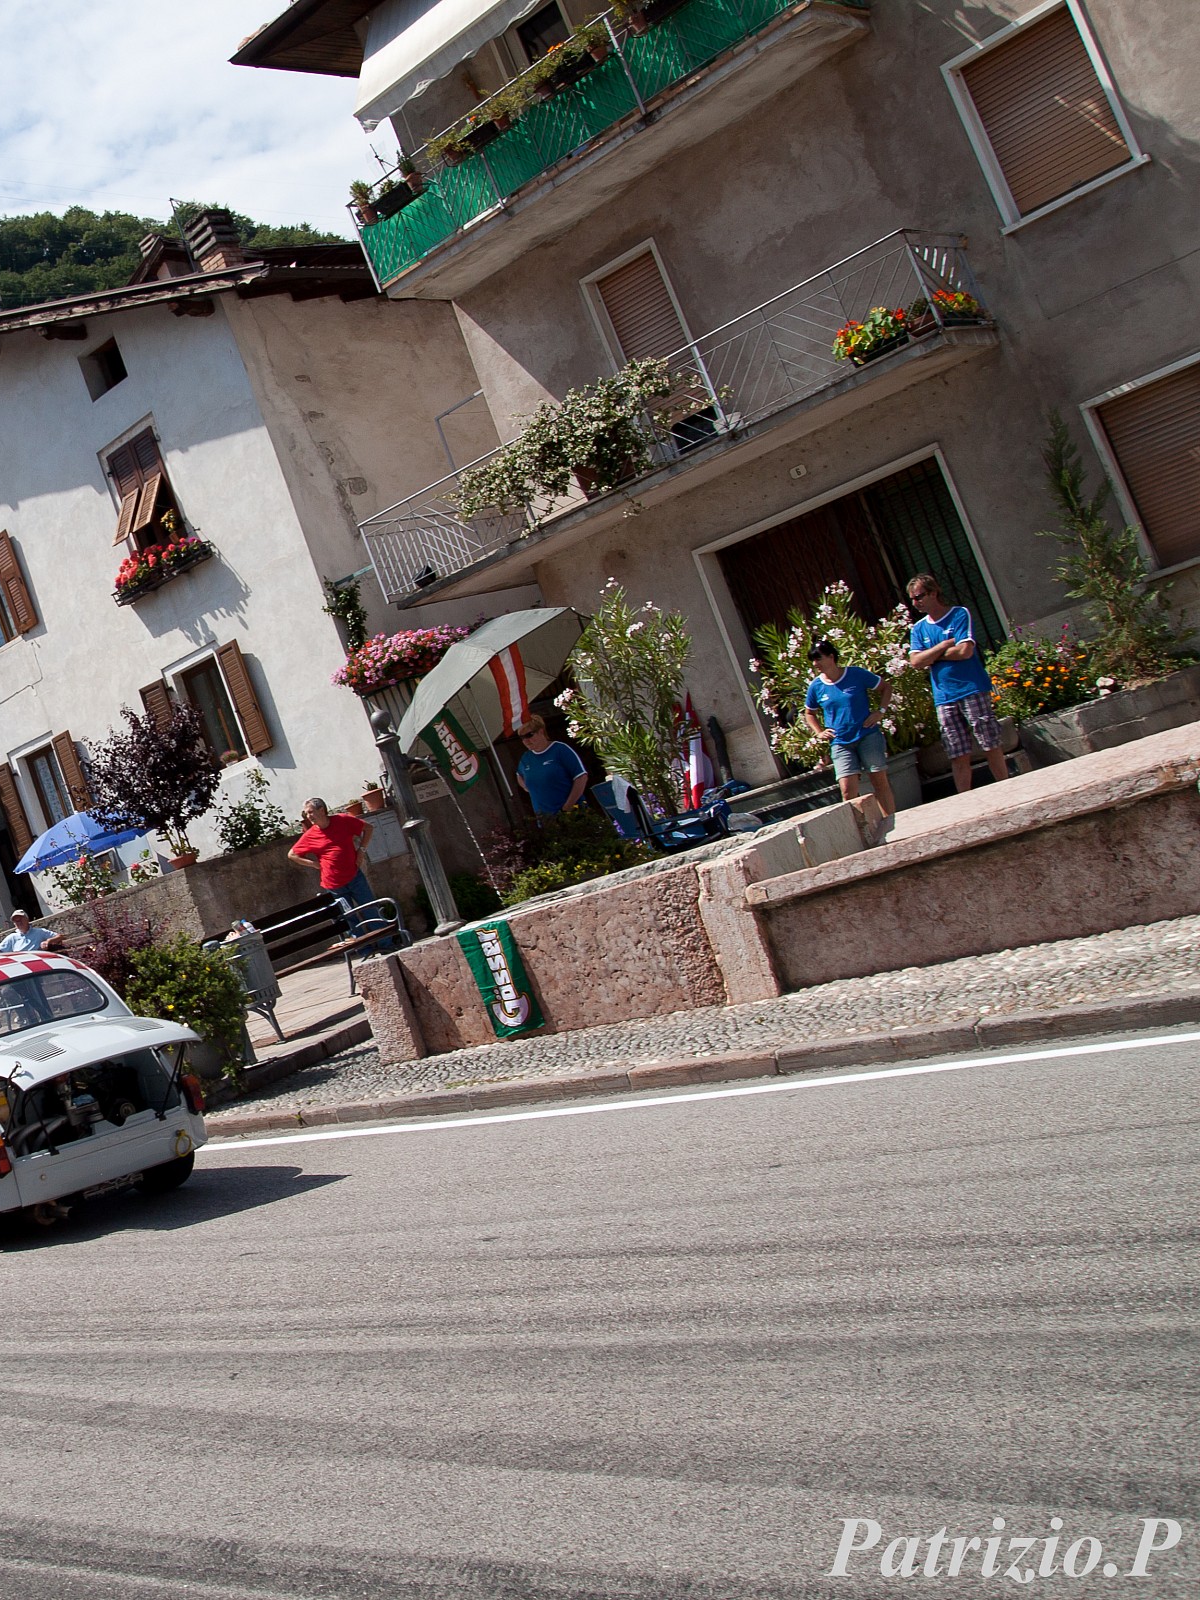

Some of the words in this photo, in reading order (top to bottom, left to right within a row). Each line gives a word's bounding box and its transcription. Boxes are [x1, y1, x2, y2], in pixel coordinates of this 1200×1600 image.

[795, 467, 802, 476] 6
[433, 718, 480, 783] Gösser
[475, 927, 532, 1028] Gösser
